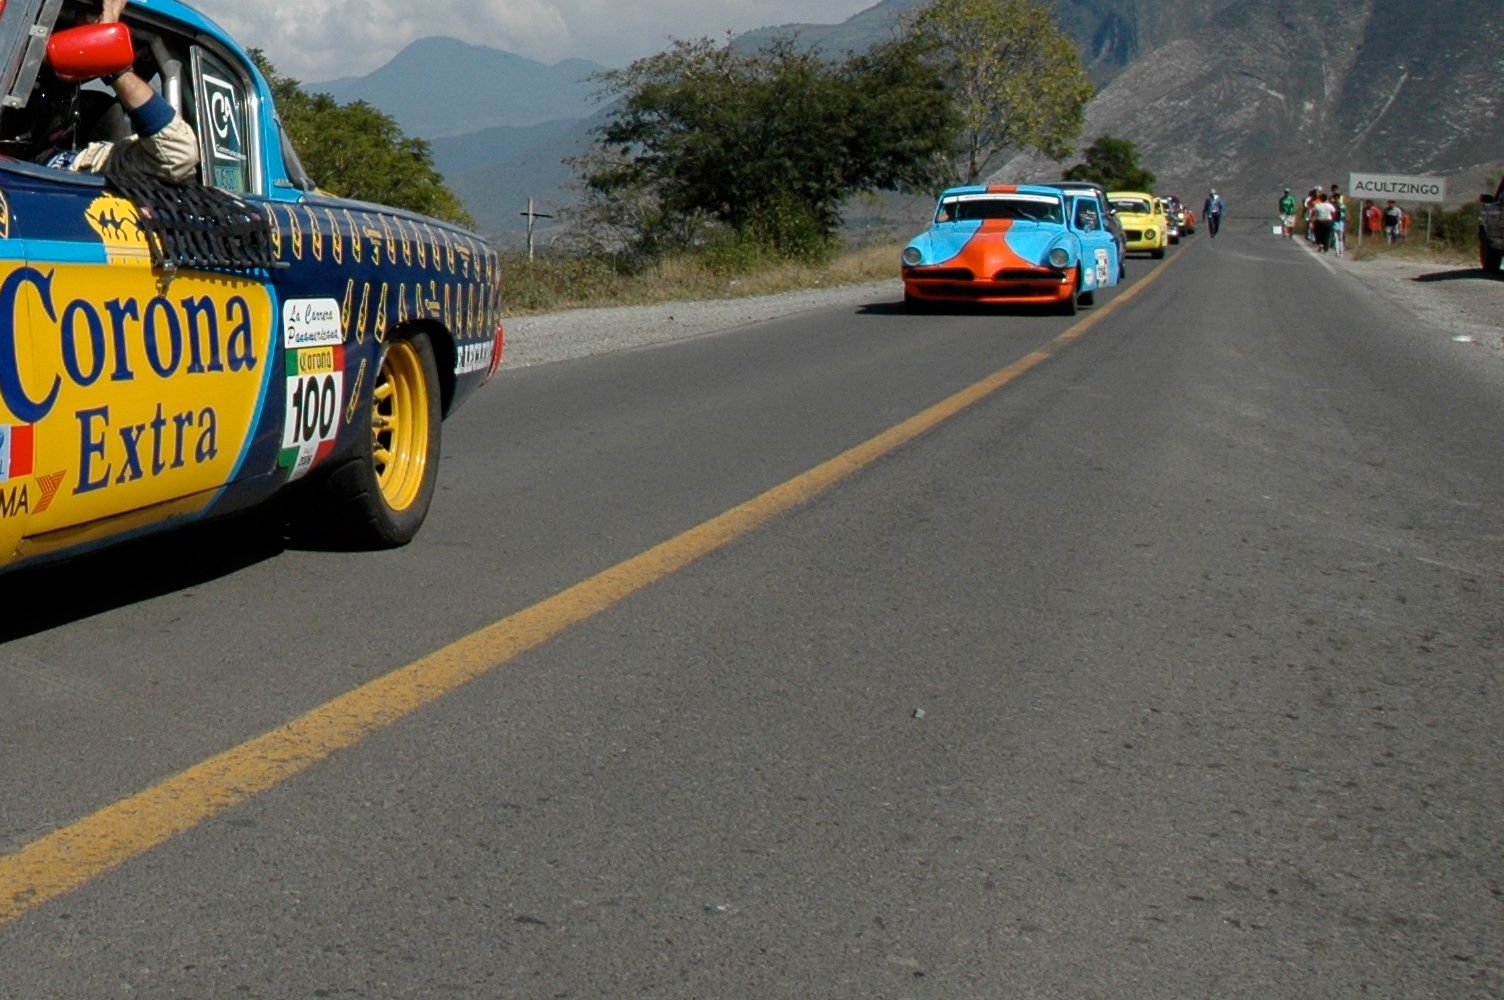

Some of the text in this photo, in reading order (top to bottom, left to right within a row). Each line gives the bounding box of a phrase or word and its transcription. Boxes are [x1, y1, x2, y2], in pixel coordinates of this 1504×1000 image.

[1355, 180, 1439, 196] ACULTZINGO
[289, 303, 333, 325] La Carrera
[287, 326, 339, 345] Panamericana
[300, 351, 332, 374] Corona
[292, 374, 336, 443] 100
[72, 402, 218, 495] Extra
